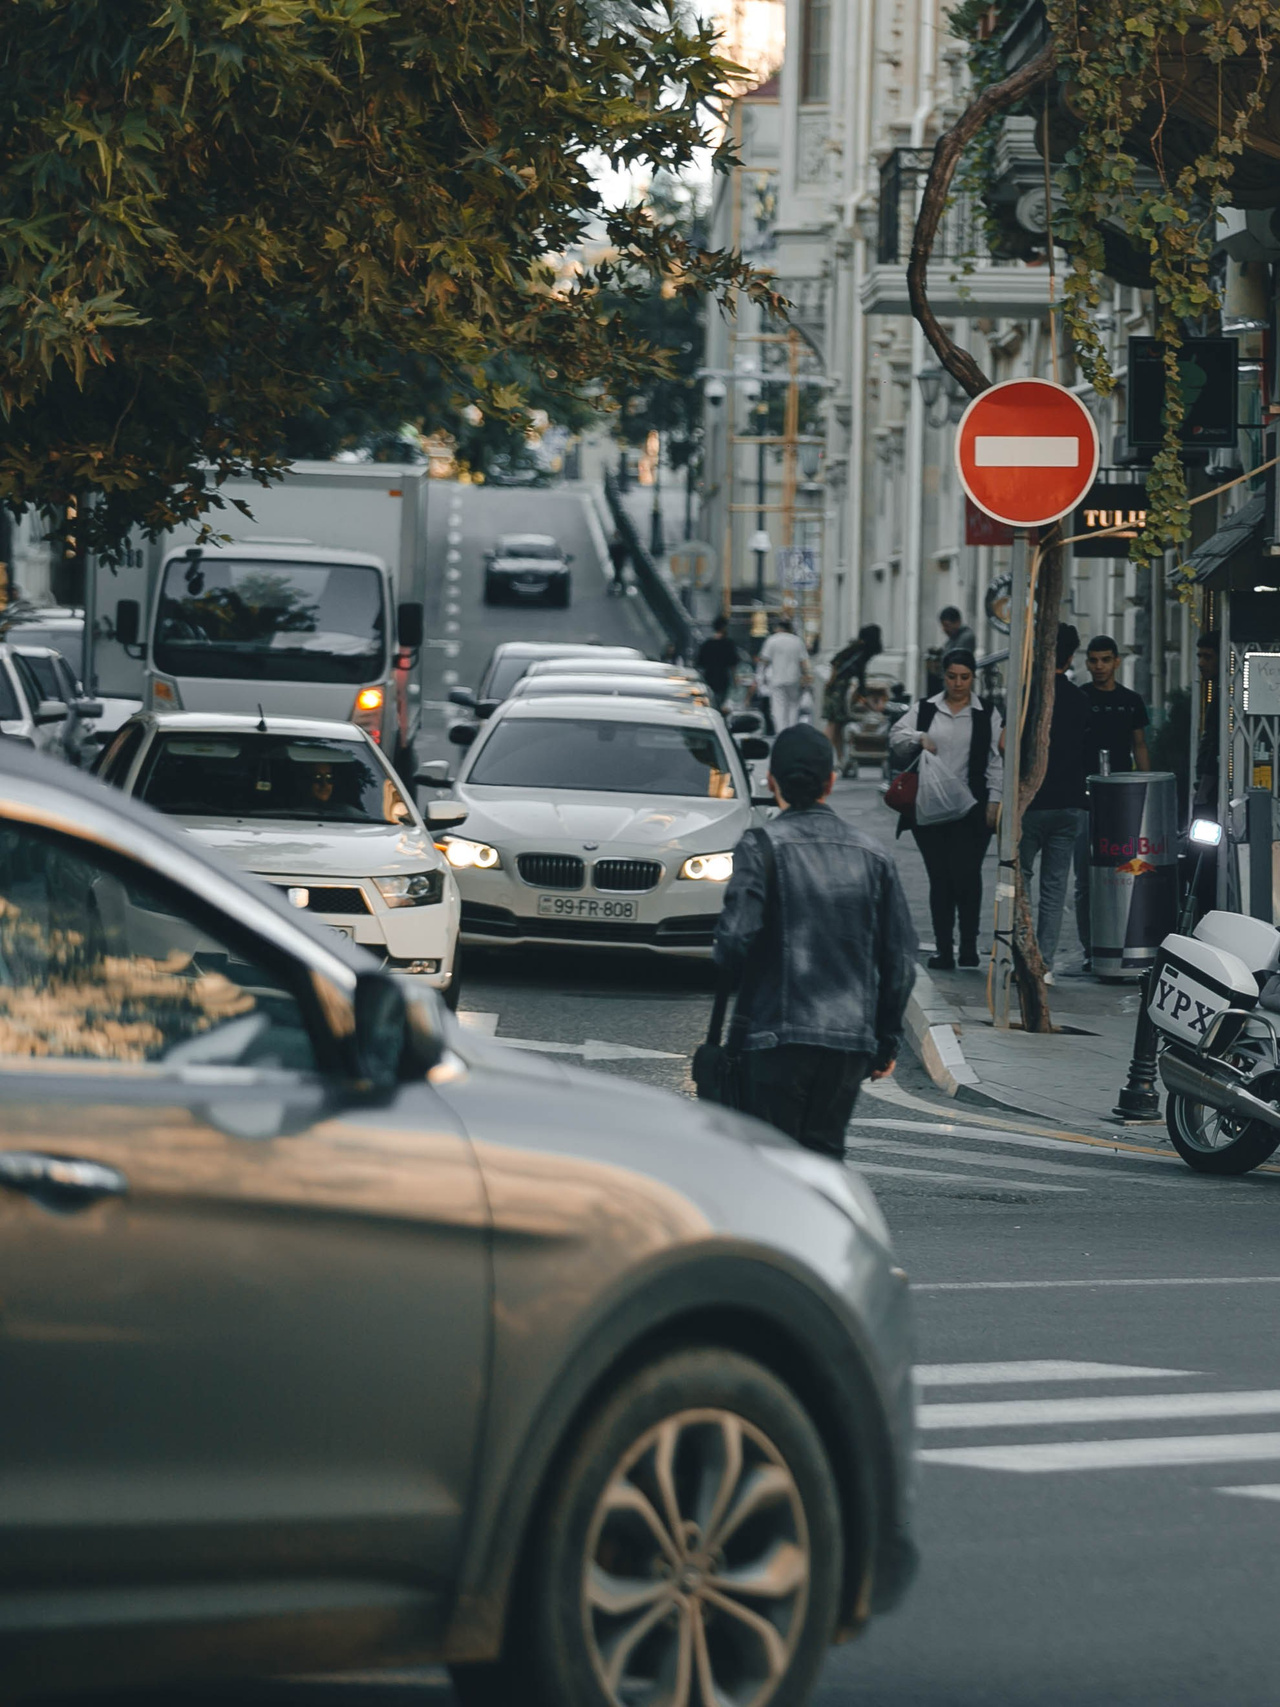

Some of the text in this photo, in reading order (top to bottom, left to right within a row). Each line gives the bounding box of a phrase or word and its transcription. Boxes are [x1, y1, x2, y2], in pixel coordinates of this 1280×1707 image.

[1099, 837, 1134, 856] Red
[554, 898, 633, 918] 99-FR-808
[1156, 979, 1216, 1035] YPX
